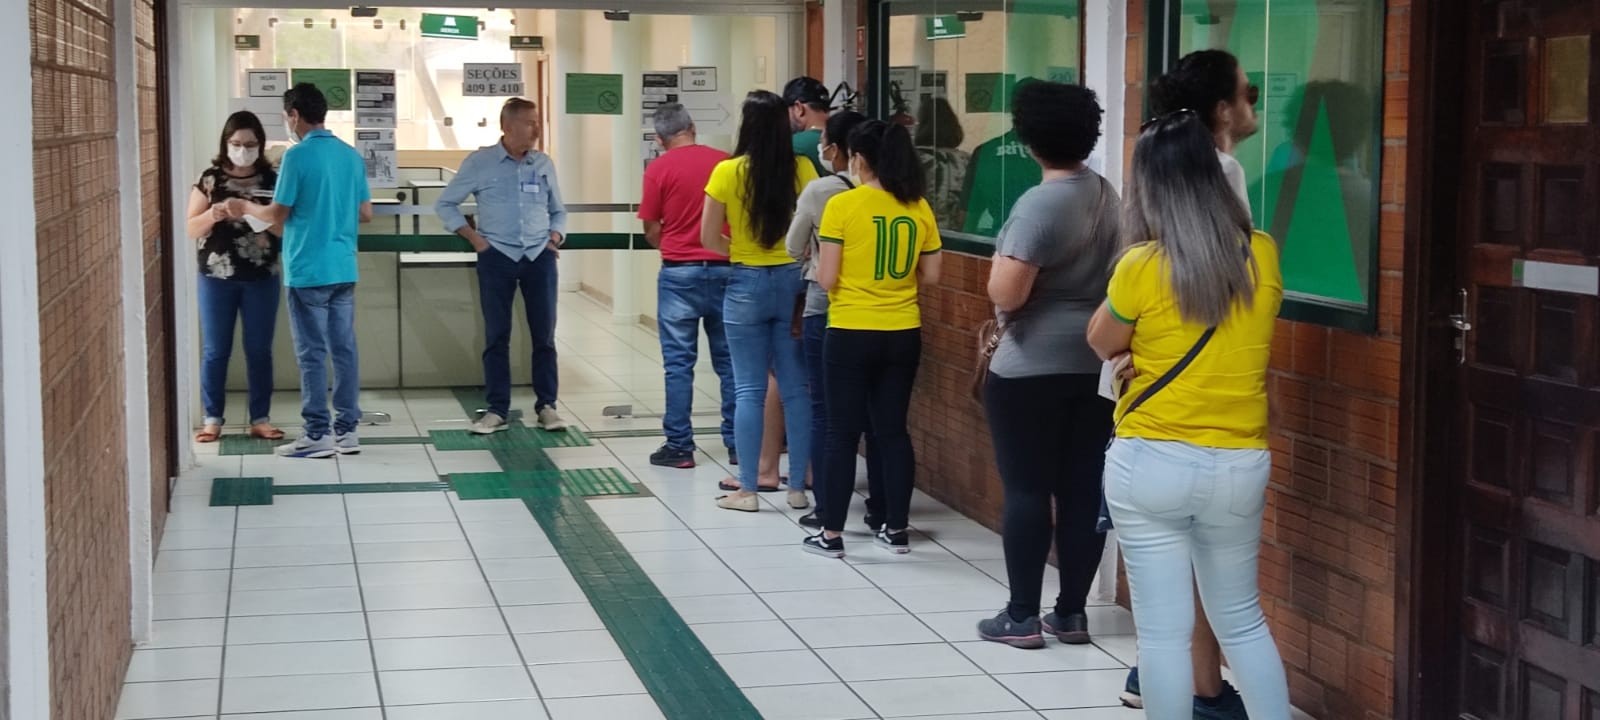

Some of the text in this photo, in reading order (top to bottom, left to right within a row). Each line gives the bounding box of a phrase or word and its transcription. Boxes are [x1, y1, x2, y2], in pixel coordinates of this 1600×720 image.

[467, 67, 517, 81] SEÇÕES
[466, 83, 519, 93] 409 E 410
[872, 216, 917, 280] 10
